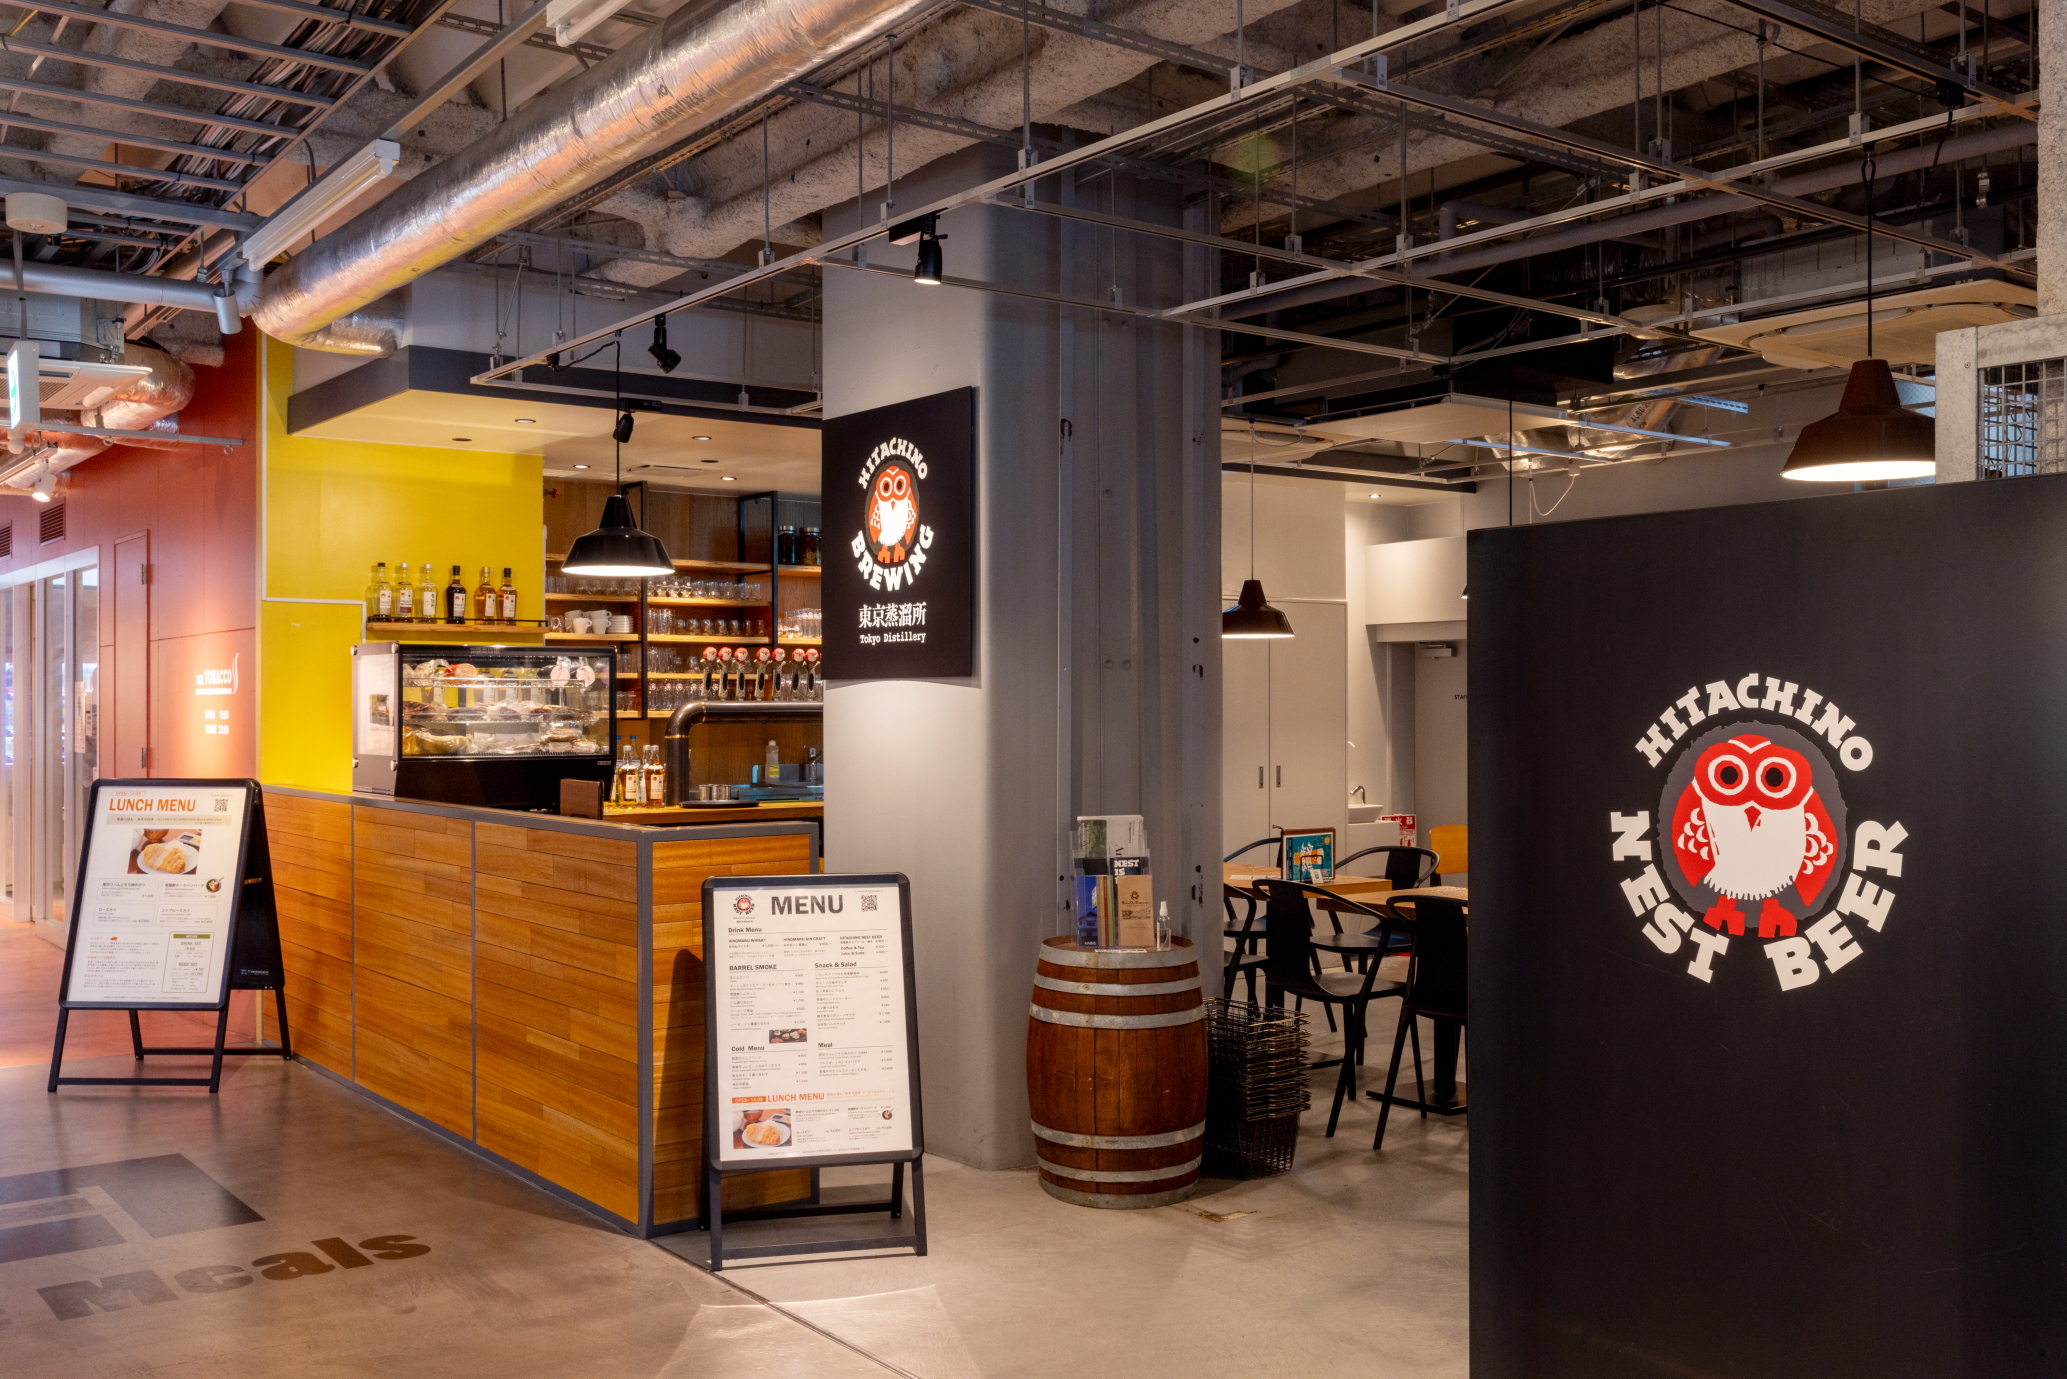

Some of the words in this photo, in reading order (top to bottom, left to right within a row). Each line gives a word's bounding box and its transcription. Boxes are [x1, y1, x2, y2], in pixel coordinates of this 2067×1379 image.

[858, 437, 928, 490] HITACHINO
[851, 524, 934, 592] BREWING
[859, 601, 927, 629] 東京蒸溜所
[860, 634, 881, 645] Tokyo
[884, 632, 926, 643] Distillery
[204, 669, 232, 685] TOBACCO
[1635, 673, 1873, 772] HITACHINO
[109, 798, 153, 812] LUNCH
[156, 798, 196, 812] MENU
[1114, 859, 1140, 868] NEST
[1114, 868, 1125, 876] IS
[771, 894, 844, 915] MENU
[1610, 810, 1730, 984] NEST
[1763, 820, 1909, 992] BEER
[767, 1094, 797, 1103] LUNCH
[799, 1092, 825, 1101] MENU
[36, 1234, 432, 1322] Meals
